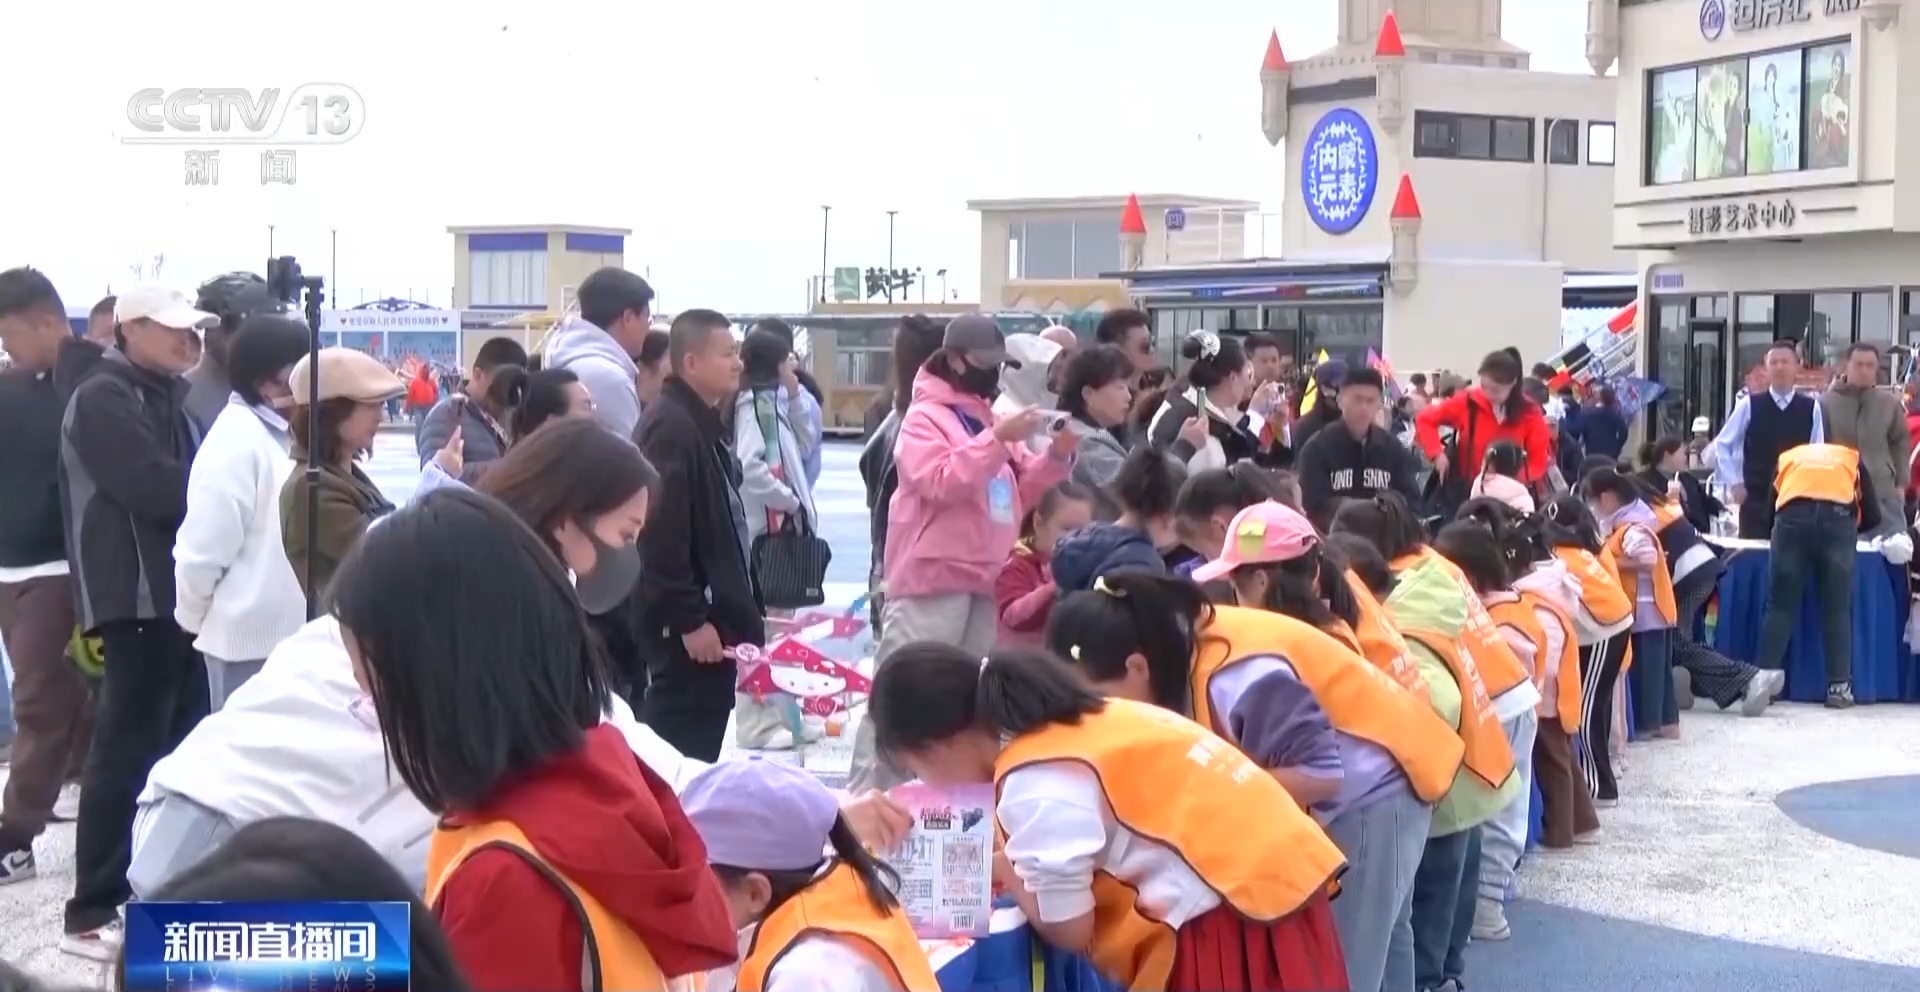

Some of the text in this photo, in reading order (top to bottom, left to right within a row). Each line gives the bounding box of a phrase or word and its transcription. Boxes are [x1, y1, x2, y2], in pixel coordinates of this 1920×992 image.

[1319, 142, 1356, 172] 内蒙
[1319, 173, 1357, 201] 元素
[1688, 198, 1796, 234] 摄影艺术中心
[865, 267, 915, 300] 蒙牛
